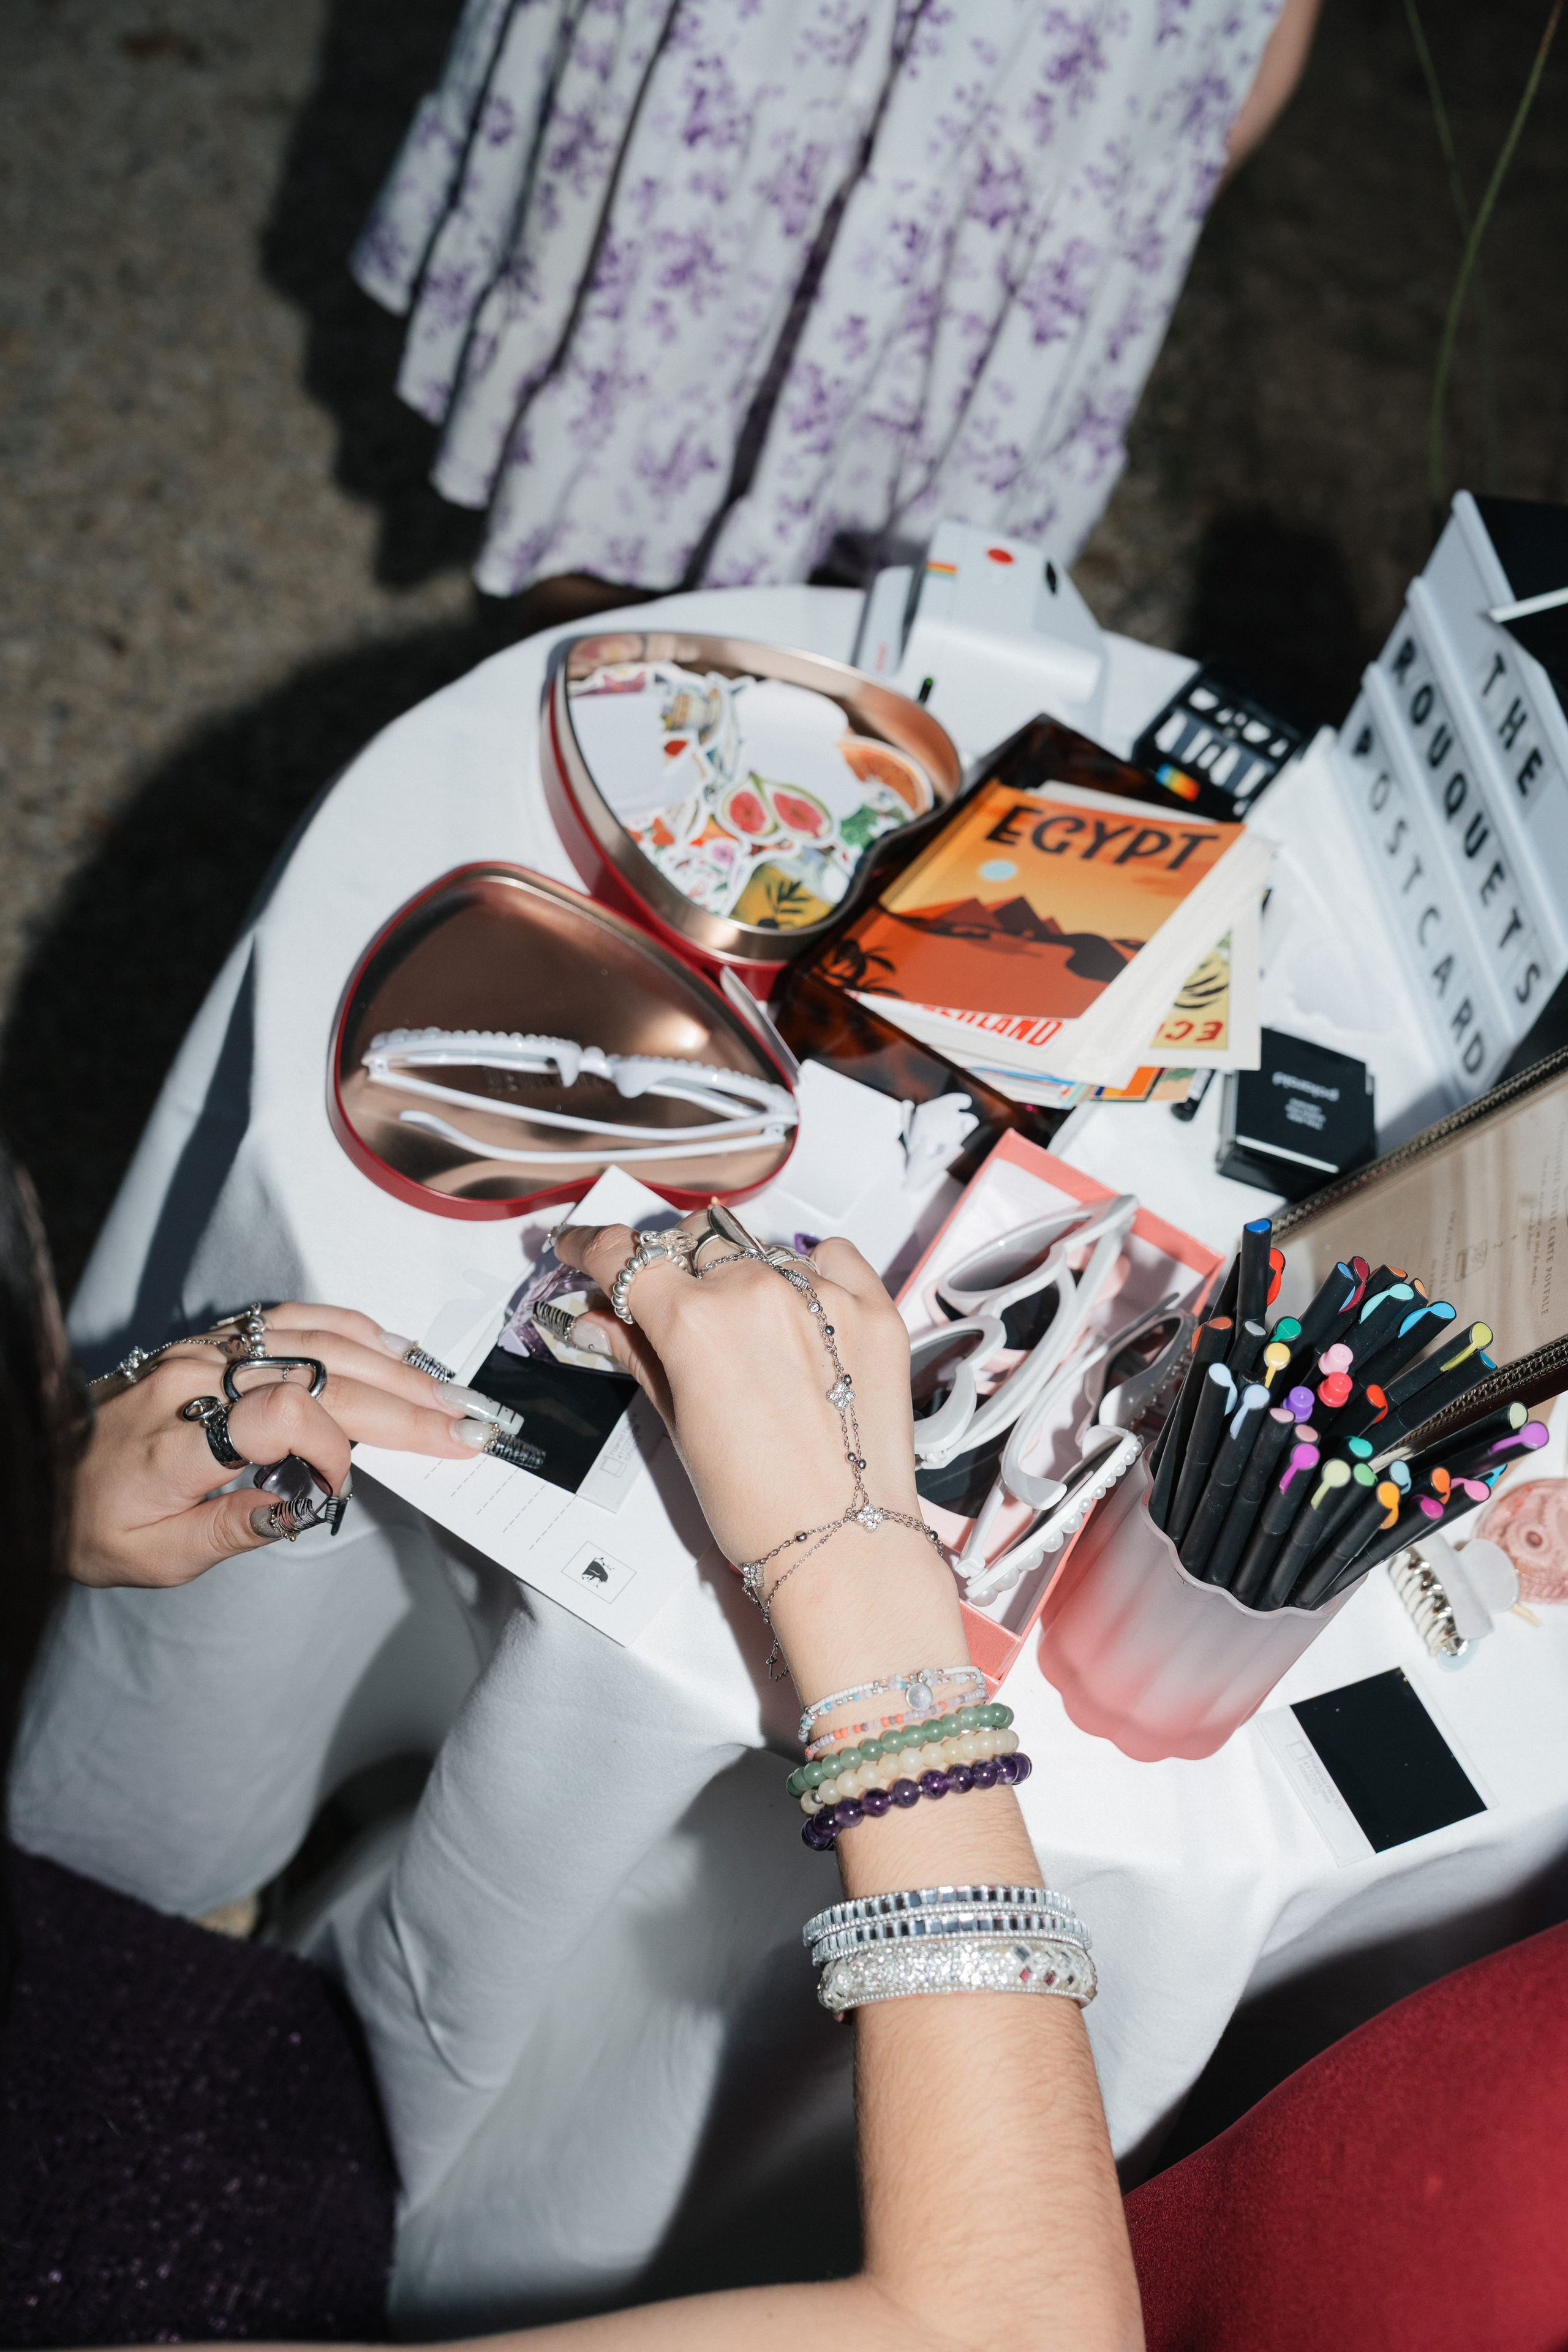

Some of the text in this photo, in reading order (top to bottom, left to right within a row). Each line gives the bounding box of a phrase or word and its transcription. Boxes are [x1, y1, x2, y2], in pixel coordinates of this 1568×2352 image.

[1483, 652, 1542, 796] THE
[985, 804, 1220, 870] EGYPT
[1545, 1226, 1556, 1263] CARTE
[1540, 1266, 1553, 1317] POSTALE
